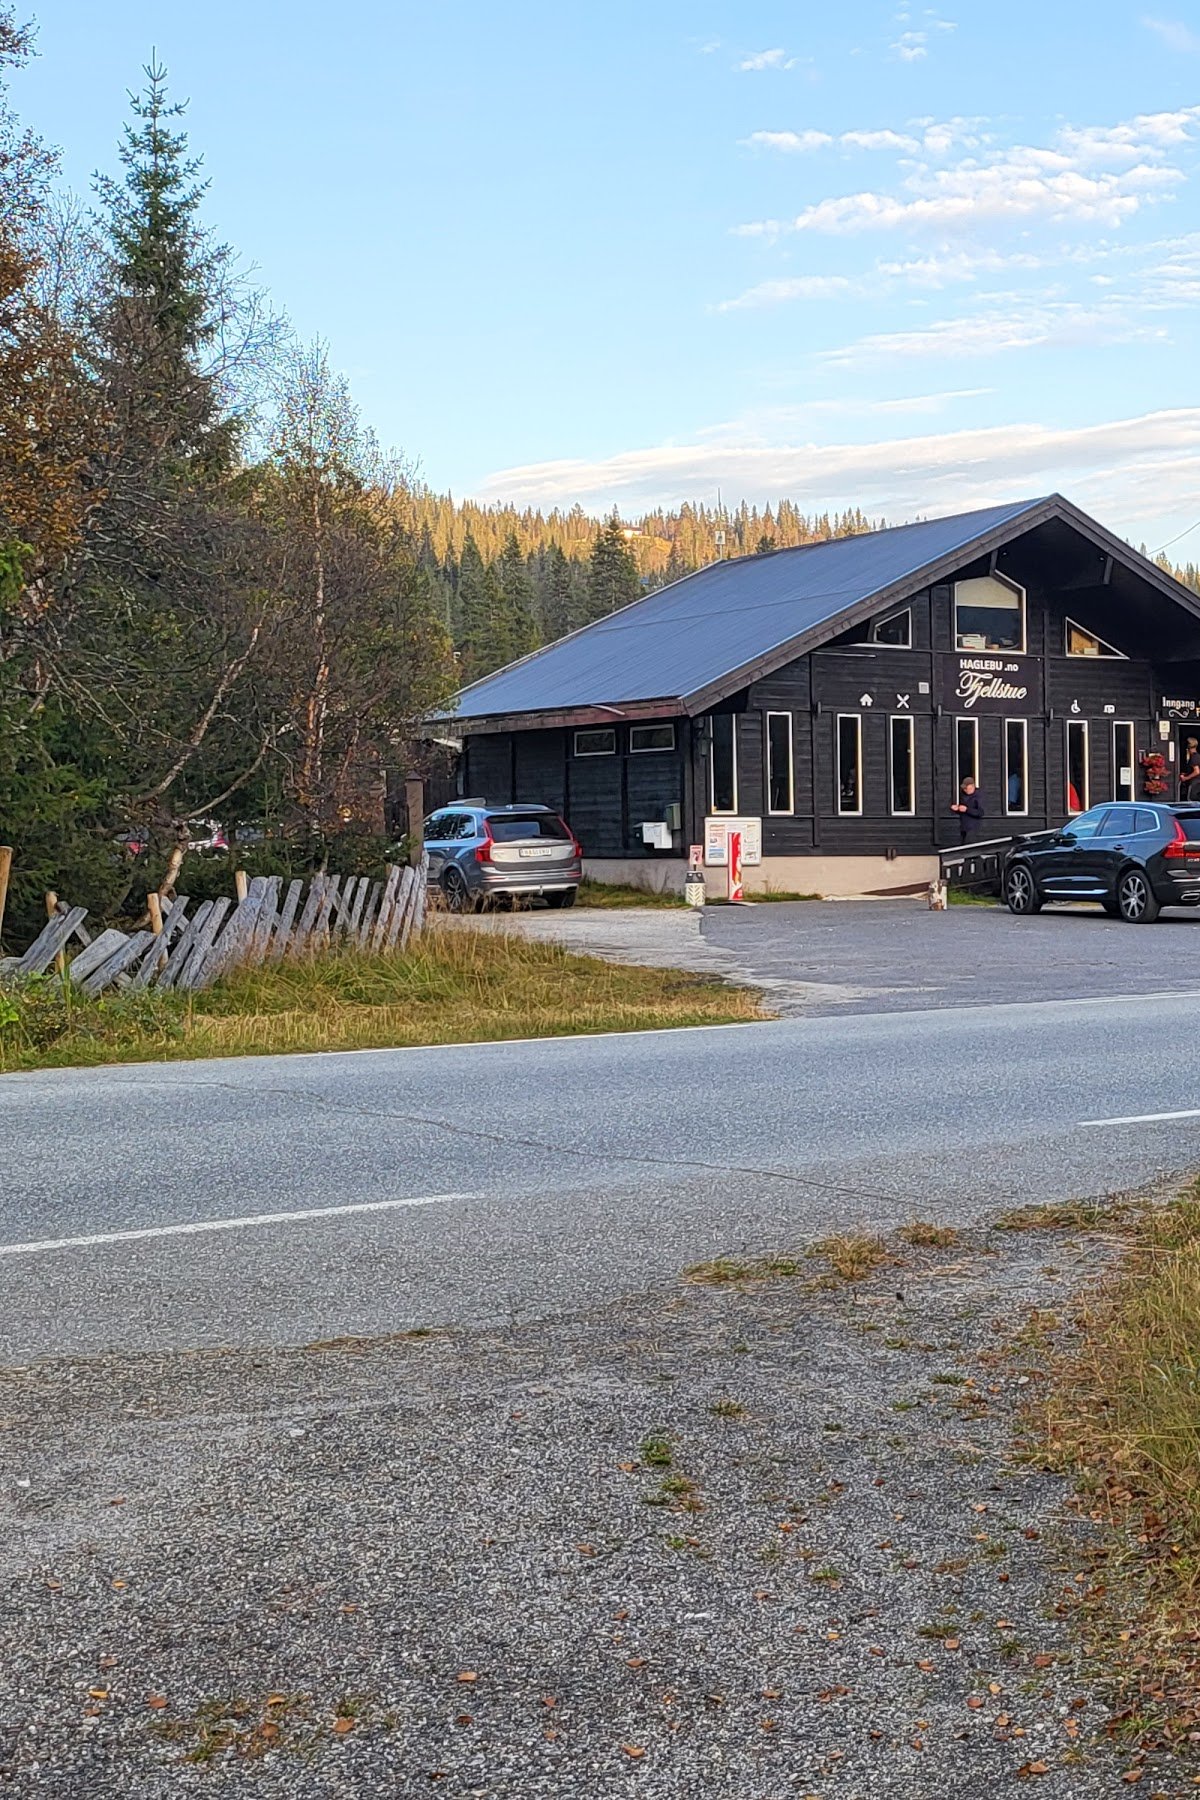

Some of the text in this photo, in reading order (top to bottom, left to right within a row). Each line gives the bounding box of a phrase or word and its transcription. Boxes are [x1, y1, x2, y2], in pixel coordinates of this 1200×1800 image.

[960, 659, 1003, 670] HAGLEBU
[955, 670, 1027, 708] Fjellstue
[1162, 696, 1195, 710] Inngang
